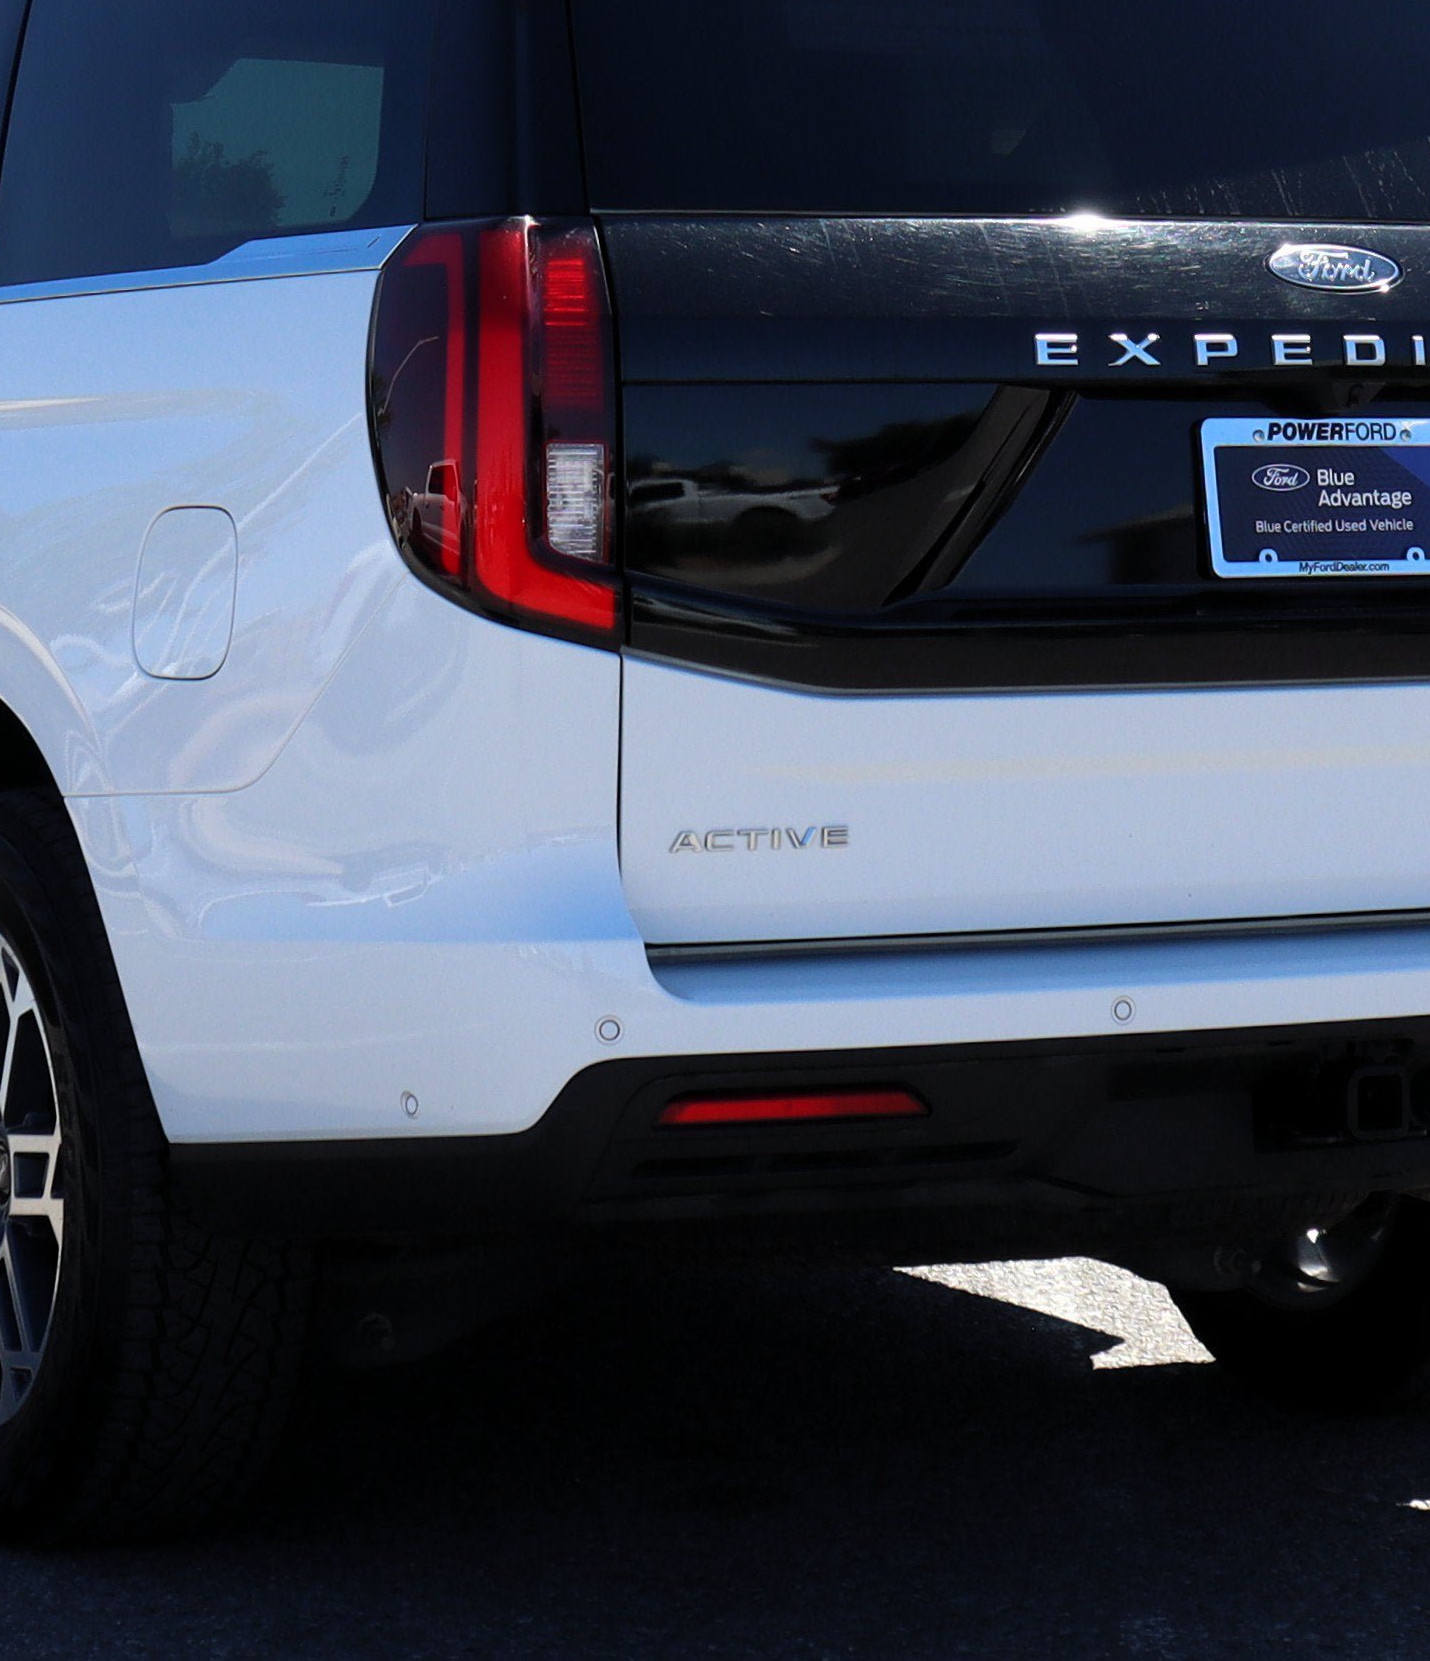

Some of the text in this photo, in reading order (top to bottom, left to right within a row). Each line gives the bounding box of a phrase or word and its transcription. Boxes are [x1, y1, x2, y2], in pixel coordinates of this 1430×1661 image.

[1297, 250, 1375, 283] Ford
[1267, 422, 1397, 442] POWERFORD
[1262, 467, 1299, 487] Ford
[1317, 468, 1355, 487] Blue
[1318, 489, 1413, 509] Advantage
[1255, 518, 1414, 533] Blue Certified Used Vehicle
[1299, 561, 1390, 576] MyFordDealer.com
[668, 825, 850, 854] ACTIVE
